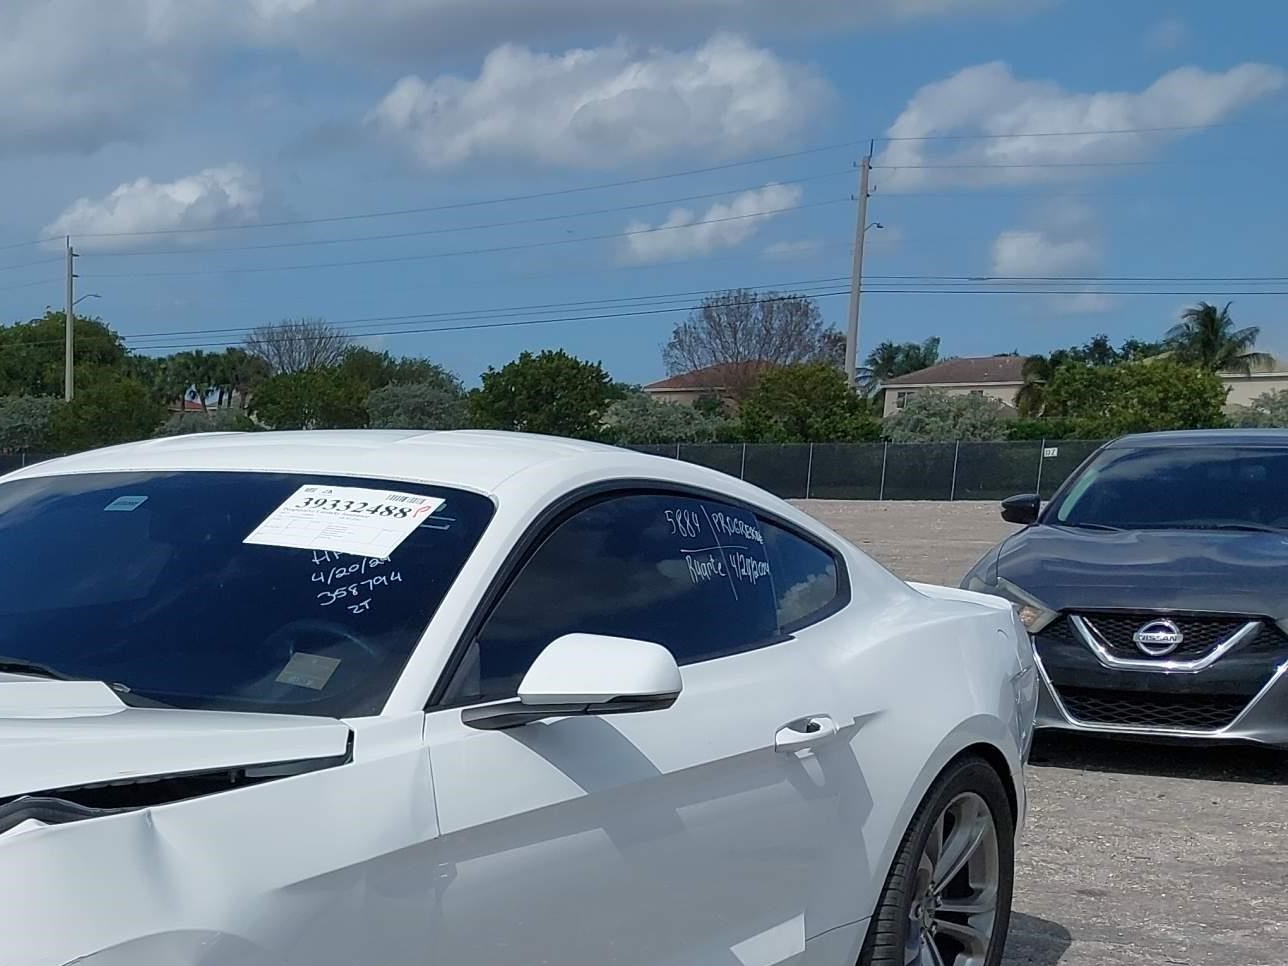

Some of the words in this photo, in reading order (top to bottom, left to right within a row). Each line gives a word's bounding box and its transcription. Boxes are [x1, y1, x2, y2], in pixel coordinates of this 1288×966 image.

[294, 496, 413, 519] 39332488
[316, 571, 403, 606] 358794
[1139, 634, 1177, 642] NISSAN
